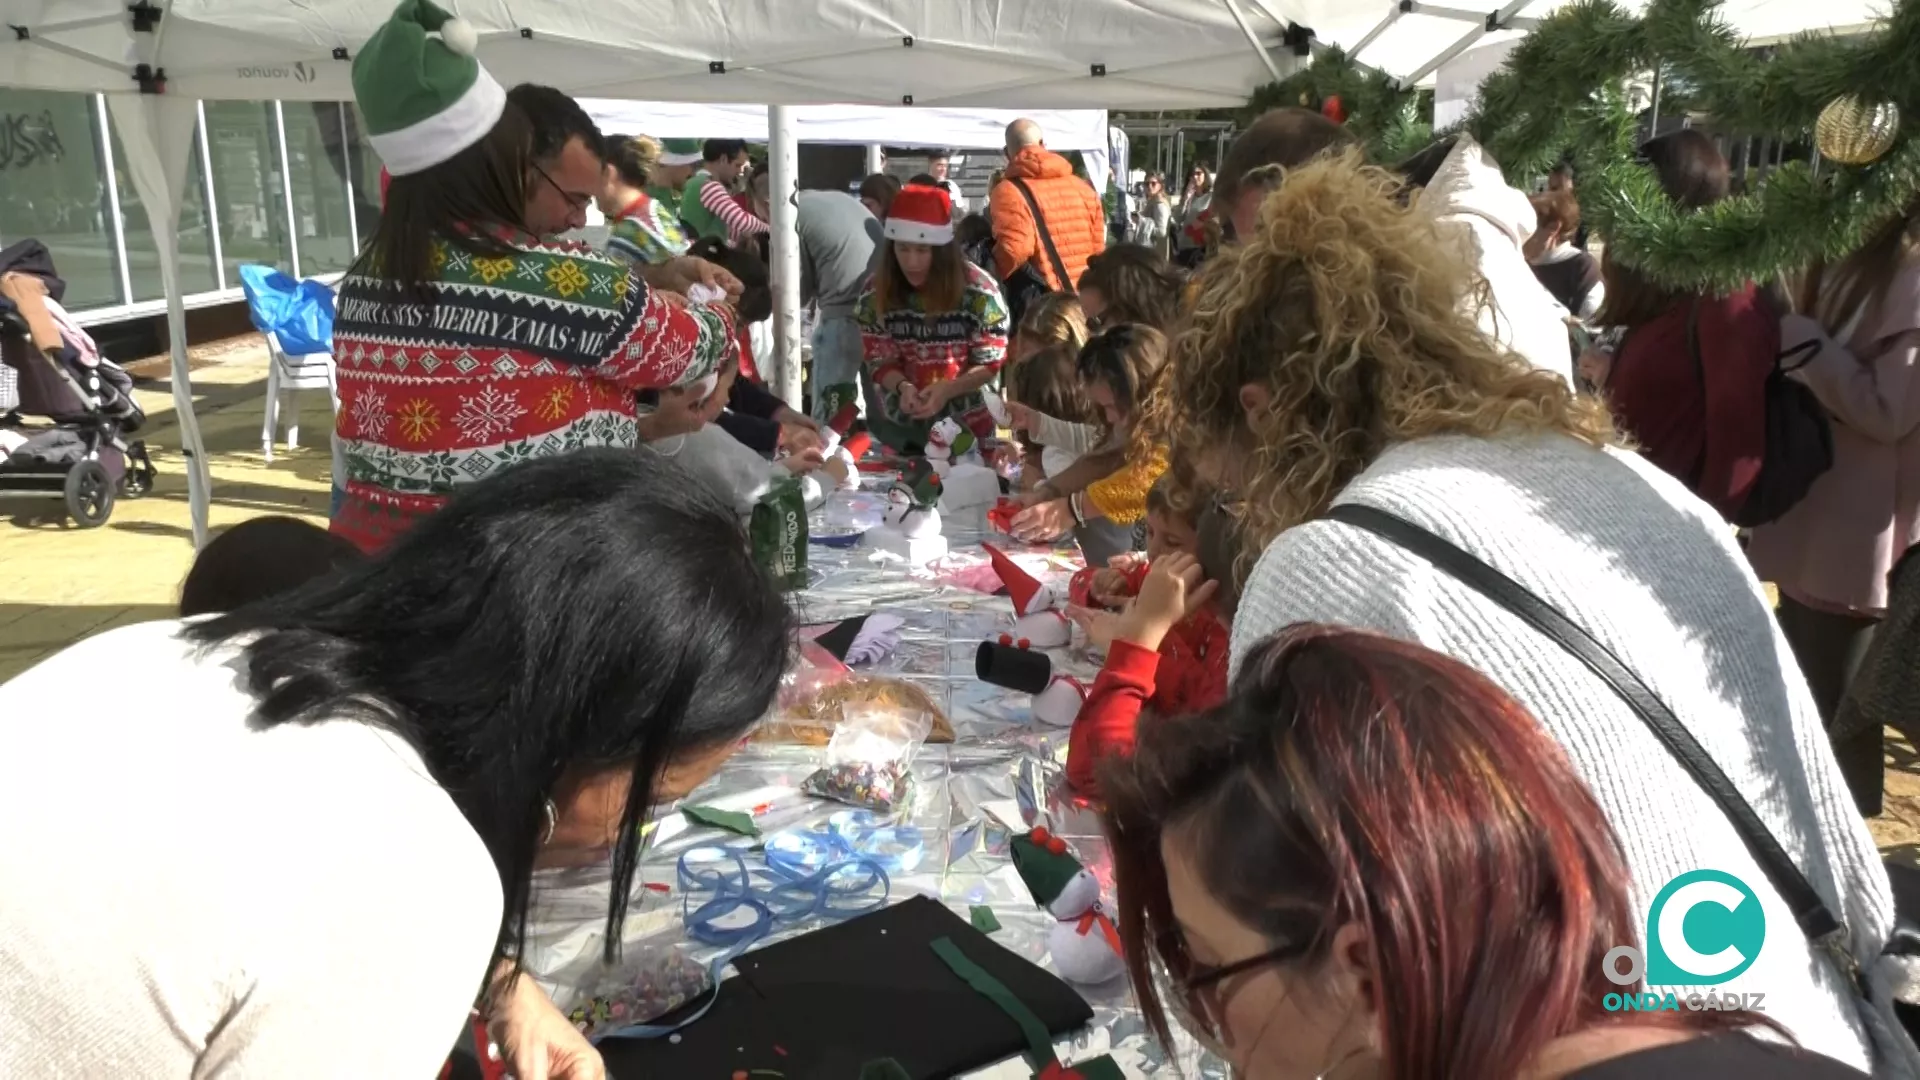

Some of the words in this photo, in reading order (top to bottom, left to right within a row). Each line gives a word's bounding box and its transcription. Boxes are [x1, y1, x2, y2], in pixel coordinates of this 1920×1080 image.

[428, 305, 505, 337] MERRY
[501, 315, 527, 342] X
[523, 319, 570, 351] MAS
